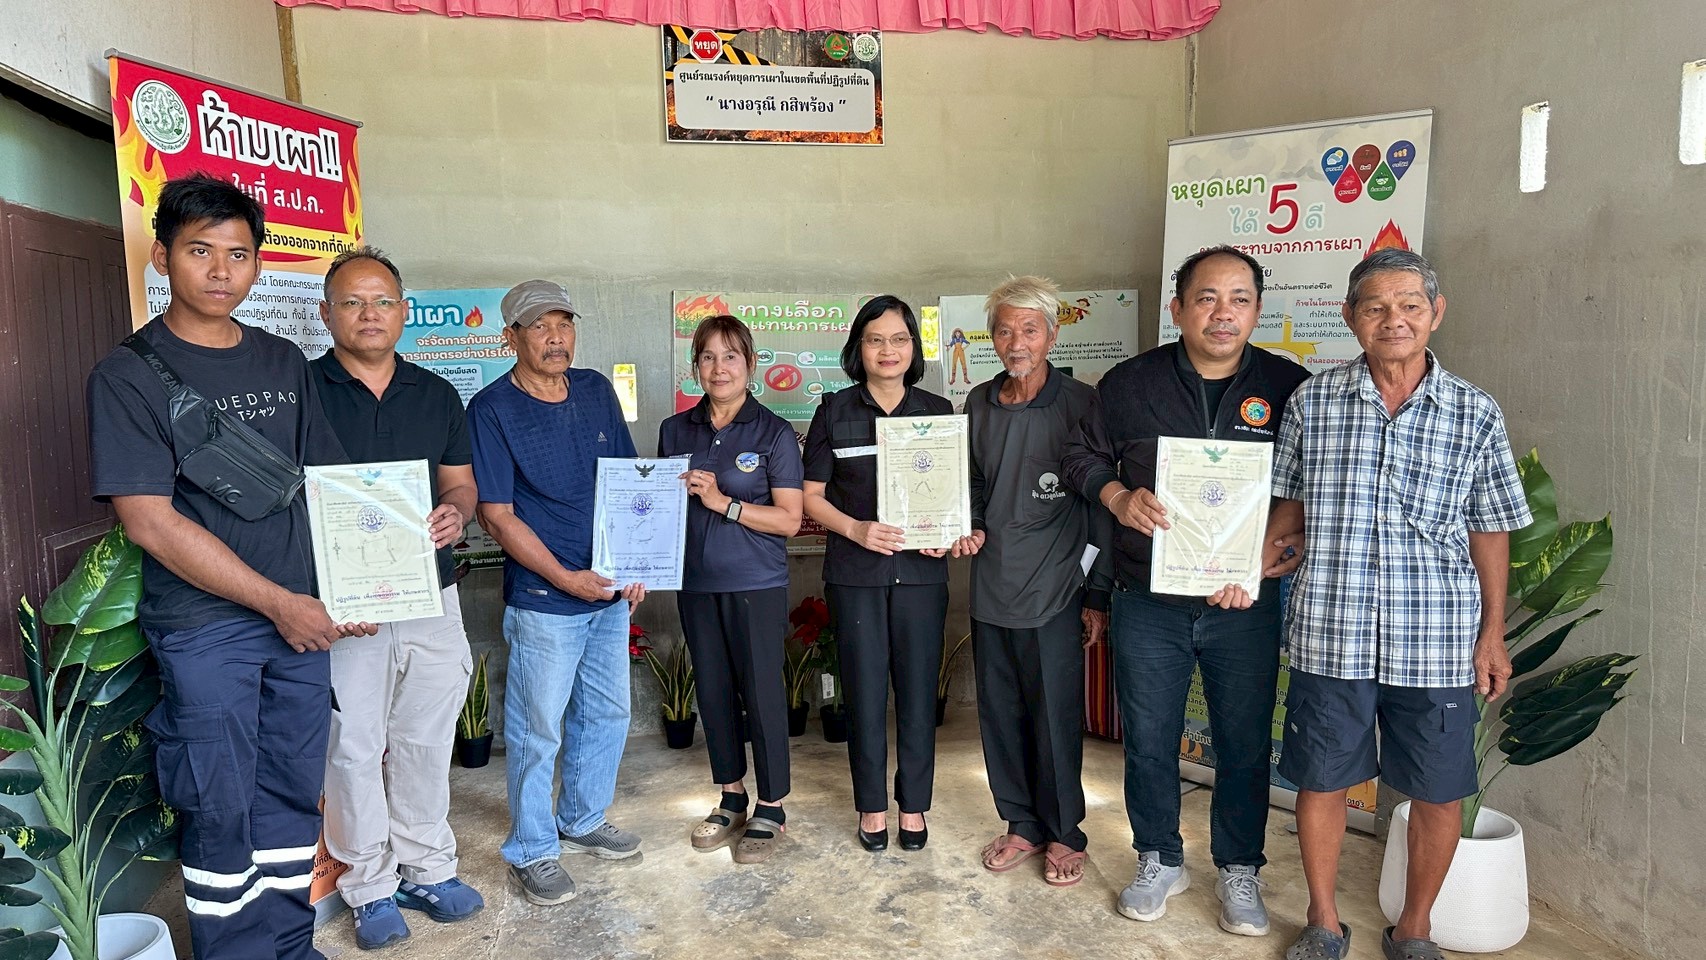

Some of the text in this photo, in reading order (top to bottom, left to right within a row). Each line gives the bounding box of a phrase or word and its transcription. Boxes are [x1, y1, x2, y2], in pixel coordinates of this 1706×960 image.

[694, 40, 718, 54] หยุด
[679, 70, 869, 88] ศูนย์รณรงค์หยุดการเผาในเขตพื้นที่ปฏิรูปที่ดิน
[718, 97, 775, 115] นางอรุณี
[780, 96, 834, 113] กสิพร้อง
[201, 96, 340, 177] ห้ามเผา!!
[274, 187, 324, 214] ส.ป.ก.
[1171, 176, 1266, 207] หยุดเผา
[1230, 184, 1324, 234] ได้ 5 ดี
[1200, 238, 1362, 256] ระทบจากการเผา
[737, 299, 844, 319] ทางเลือก
